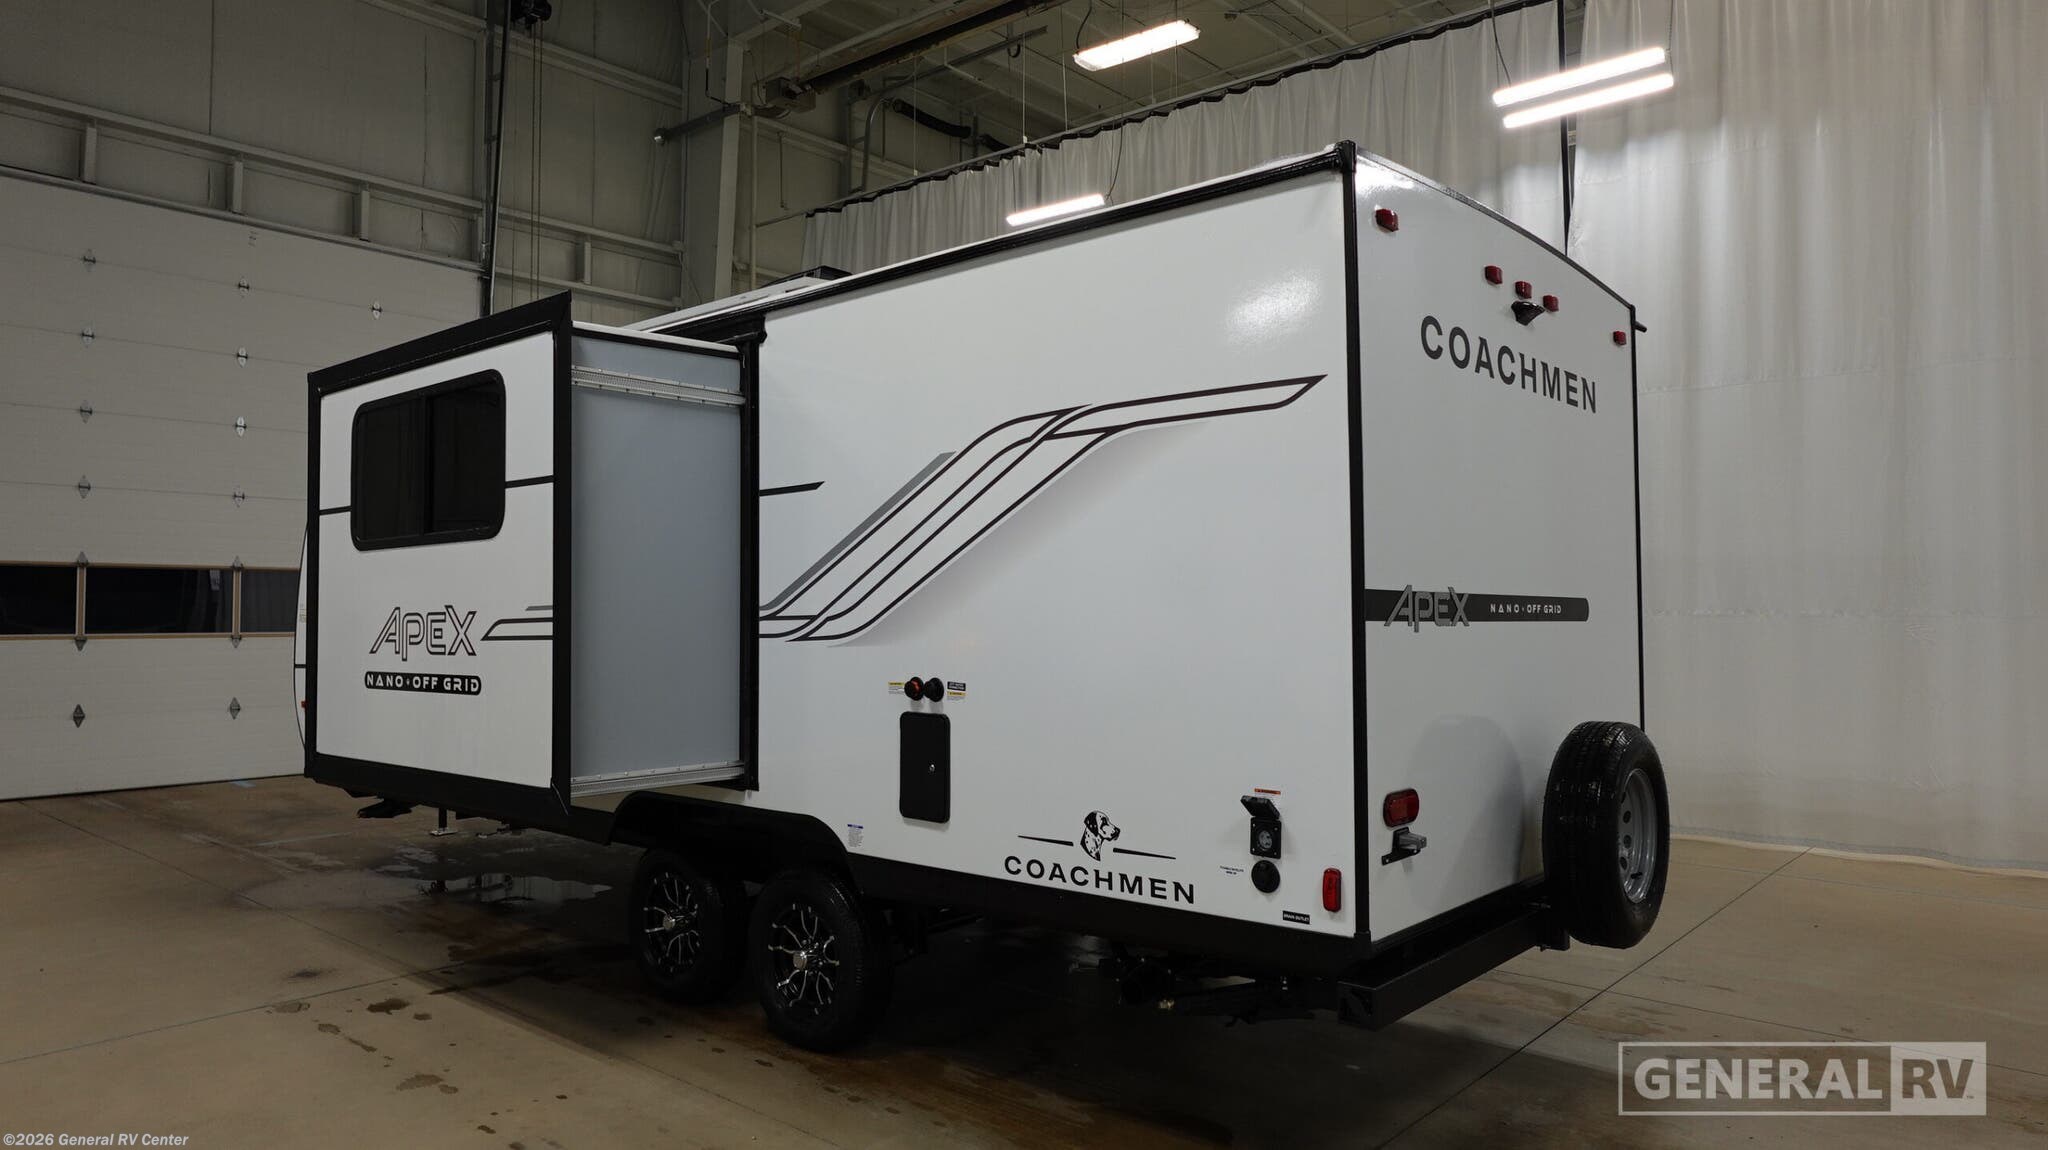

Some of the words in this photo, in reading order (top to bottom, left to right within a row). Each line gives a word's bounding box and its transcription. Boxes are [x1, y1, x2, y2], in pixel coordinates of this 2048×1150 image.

[1420, 315, 1596, 414] COACHMEN
[369, 605, 477, 661] APEX
[1384, 584, 1470, 633] APEX
[1490, 603, 1520, 613] NANO
[1527, 604, 1541, 613] OFF
[1543, 604, 1562, 614] GRID
[366, 673, 403, 687] NANO
[412, 676, 438, 689] OFF
[443, 677, 480, 692] GRID
[1004, 855, 1194, 904] COACHMEN
